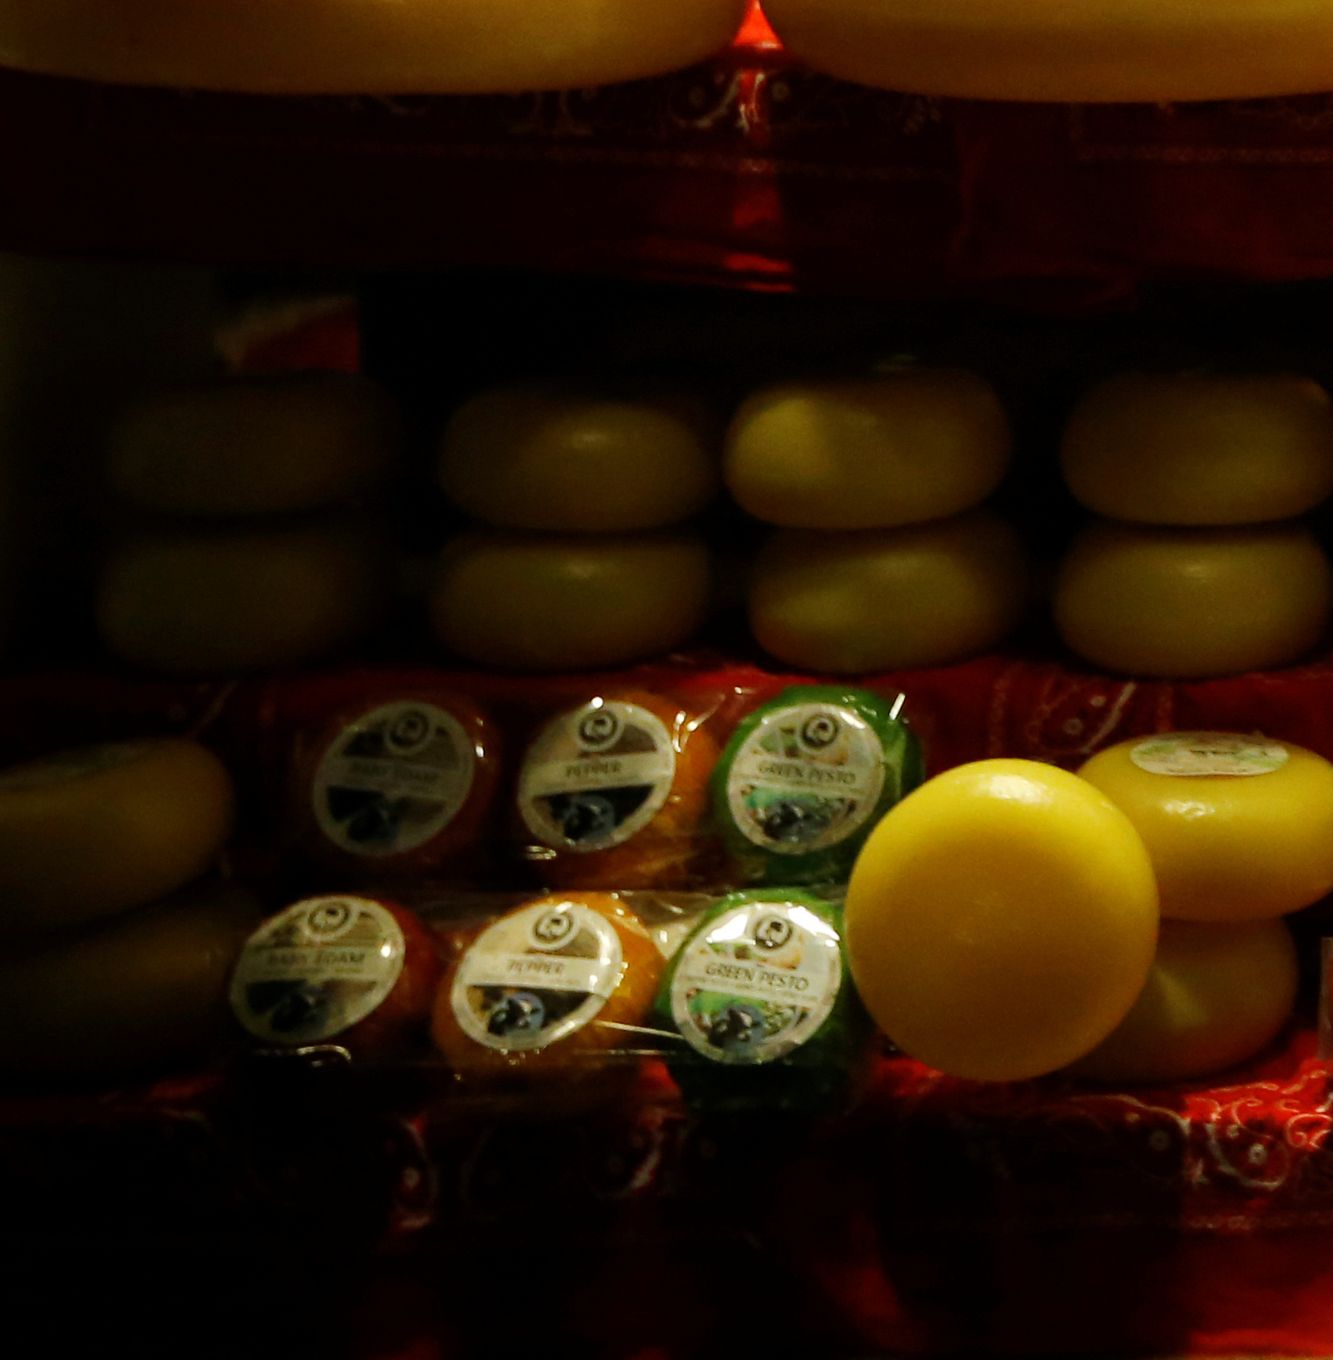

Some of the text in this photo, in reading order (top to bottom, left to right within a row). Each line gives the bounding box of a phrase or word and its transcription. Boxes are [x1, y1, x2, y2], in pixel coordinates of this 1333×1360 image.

[566, 761, 621, 777] PEPPER
[759, 761, 857, 784] GREEN PESTO
[507, 959, 564, 975] PEPPER
[704, 961, 809, 992] GREEN PESTO
